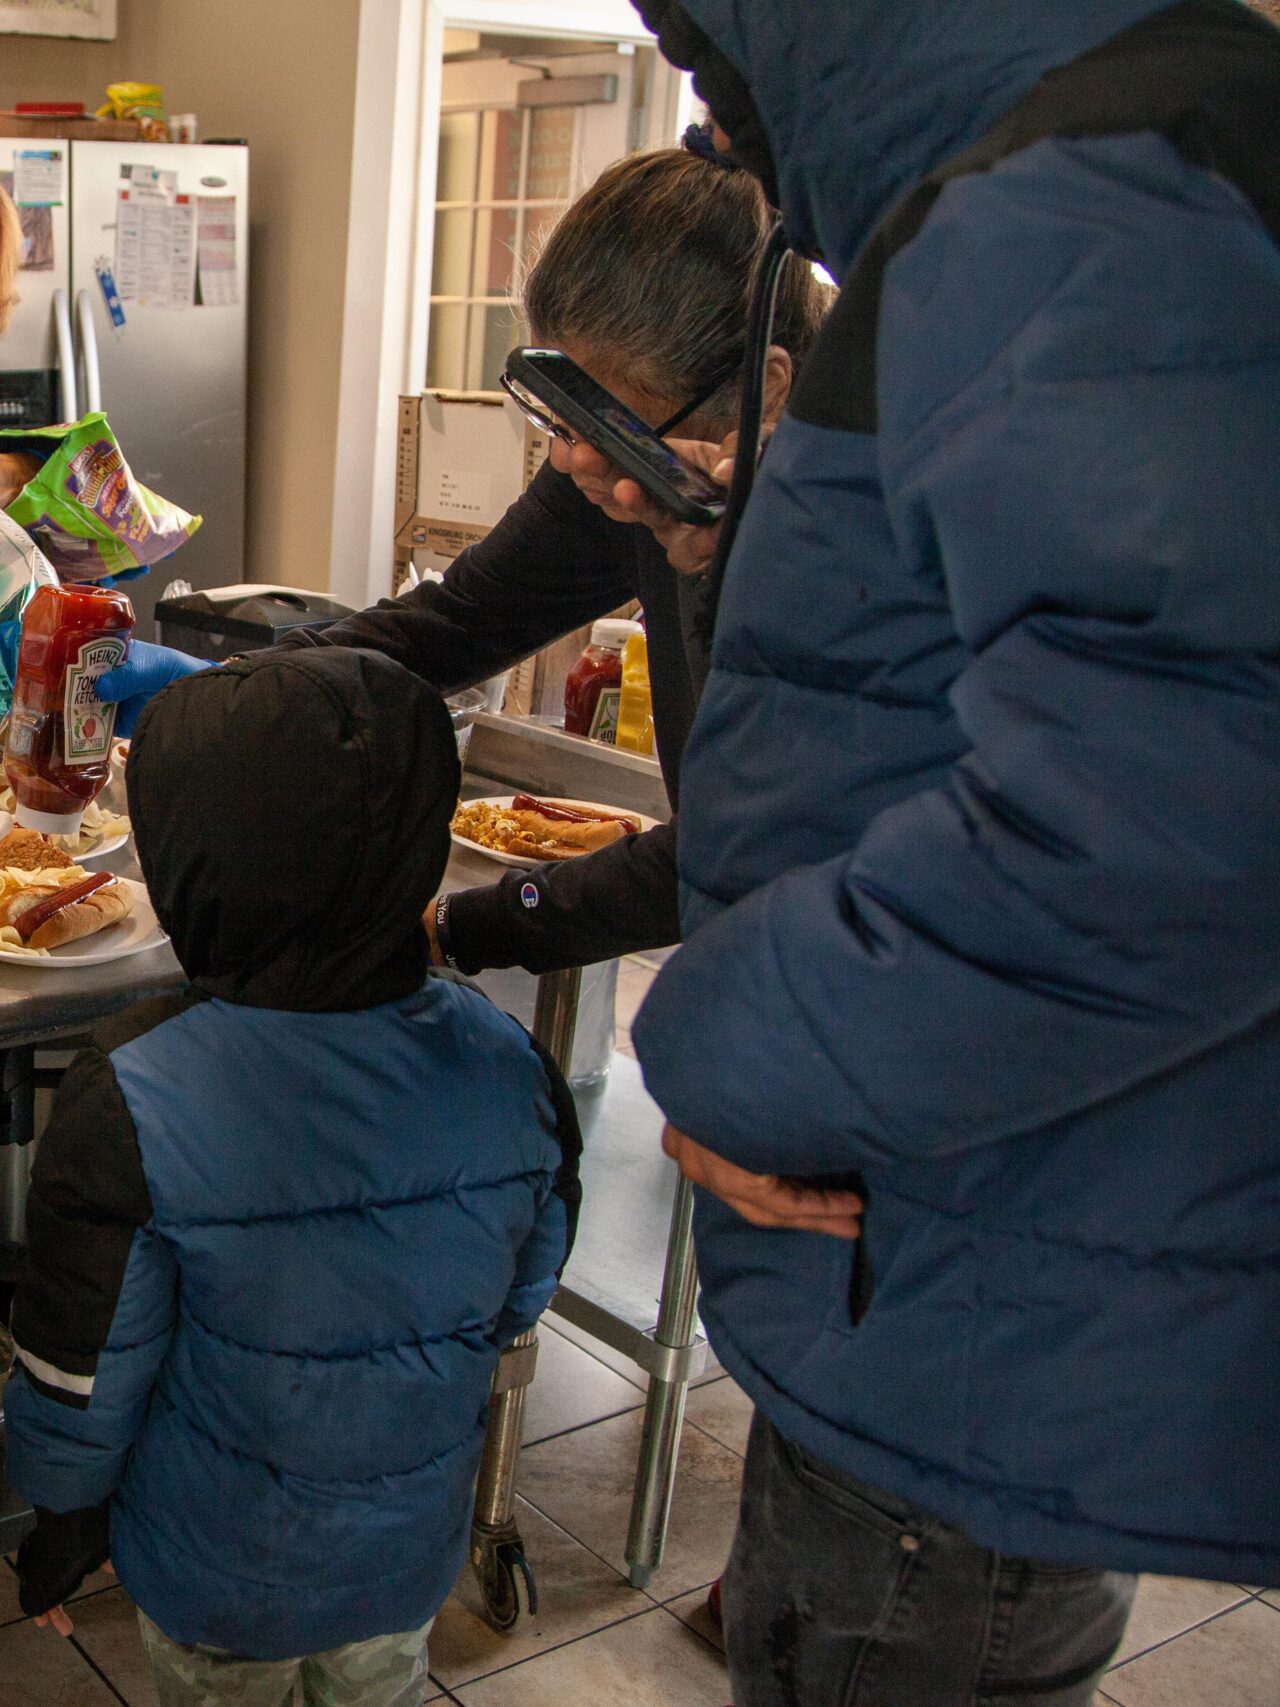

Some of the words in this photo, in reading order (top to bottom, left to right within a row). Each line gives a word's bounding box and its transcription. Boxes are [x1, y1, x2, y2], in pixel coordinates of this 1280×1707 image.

[464, 532, 482, 542] ORCH
[89, 649, 117, 666] HEINZ
[77, 674, 99, 692] TOM
[75, 690, 105, 705] KETCH
[437, 905, 447, 924] You
